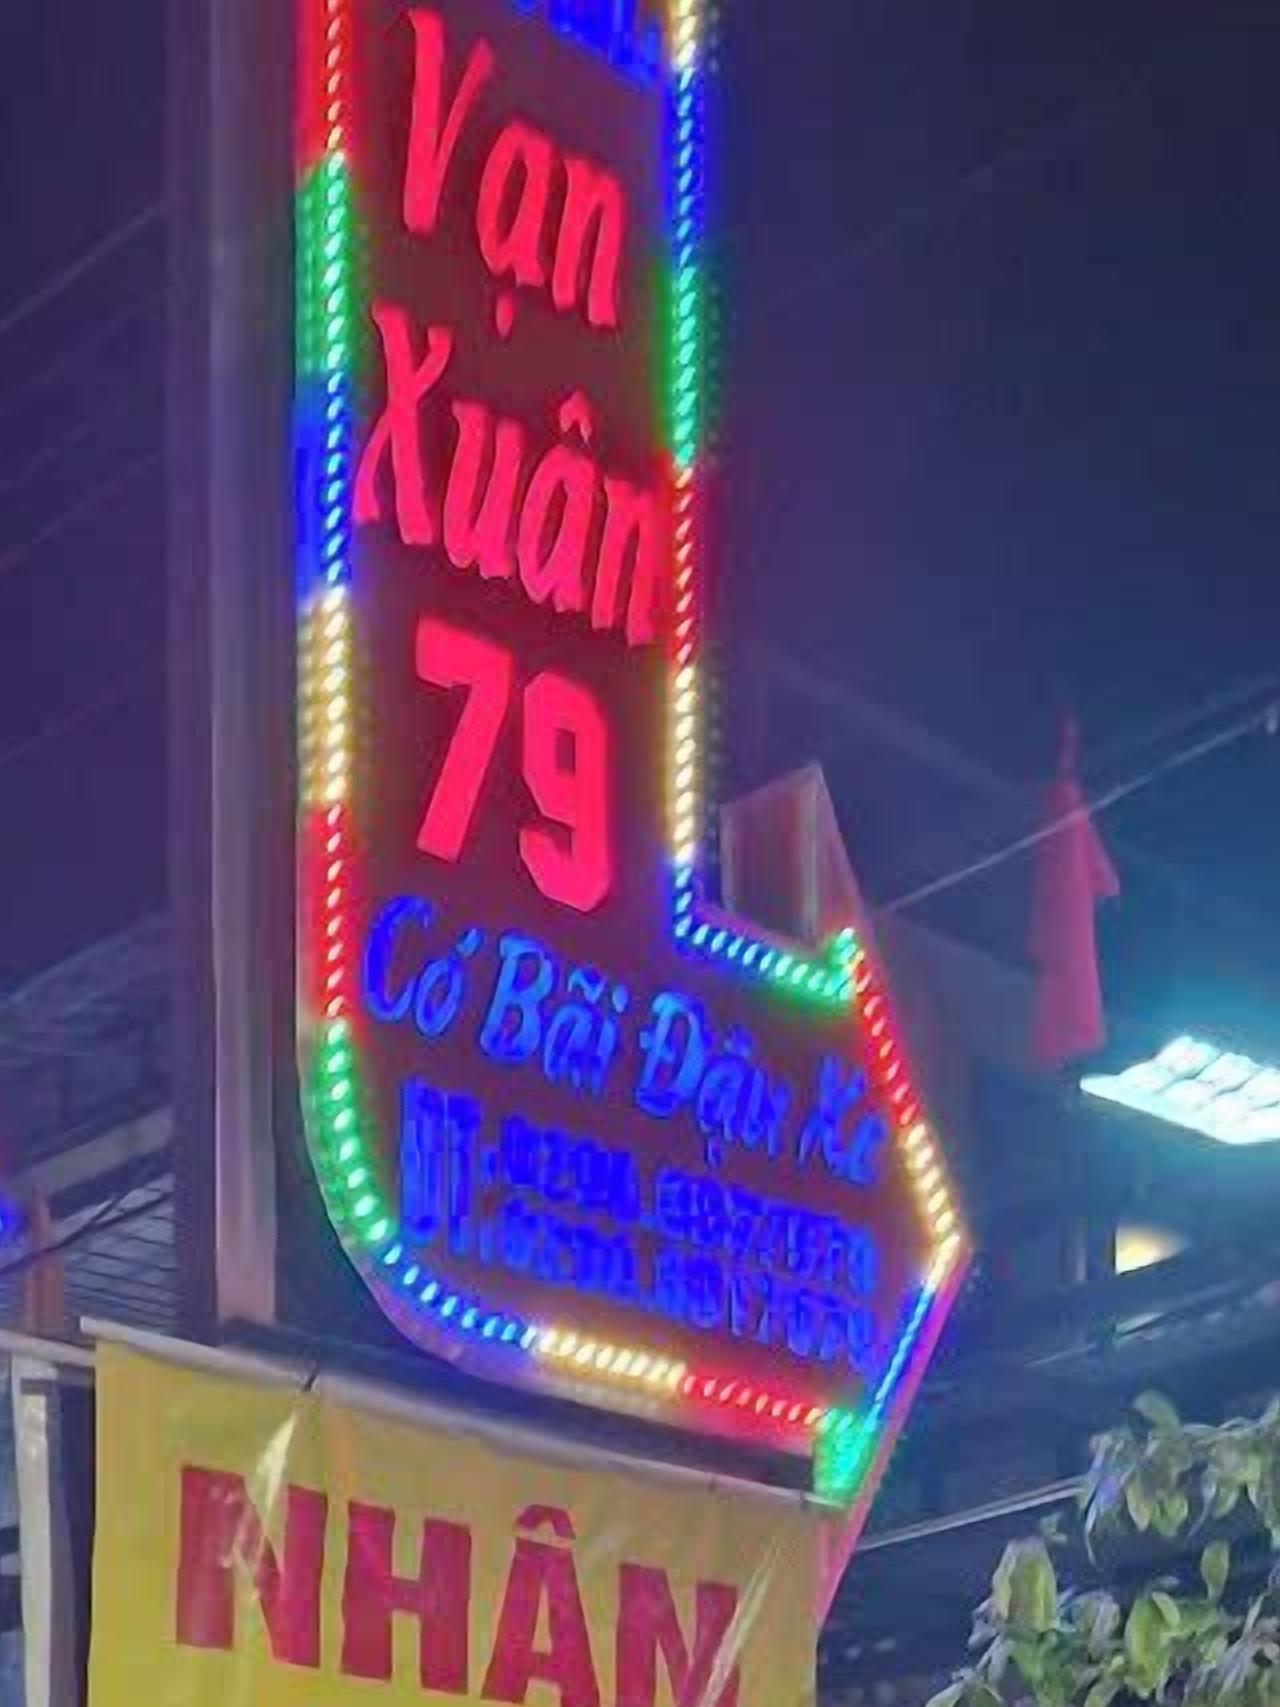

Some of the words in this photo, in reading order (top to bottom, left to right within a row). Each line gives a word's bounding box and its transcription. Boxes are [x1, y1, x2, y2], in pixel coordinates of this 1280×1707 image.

[402, 8, 625, 338] Vạn
[353, 302, 670, 646] Xuân
[414, 614, 610, 911] 79
[361, 896, 483, 1036] Có
[479, 931, 628, 1096] Bãi
[634, 992, 793, 1166] Đậu
